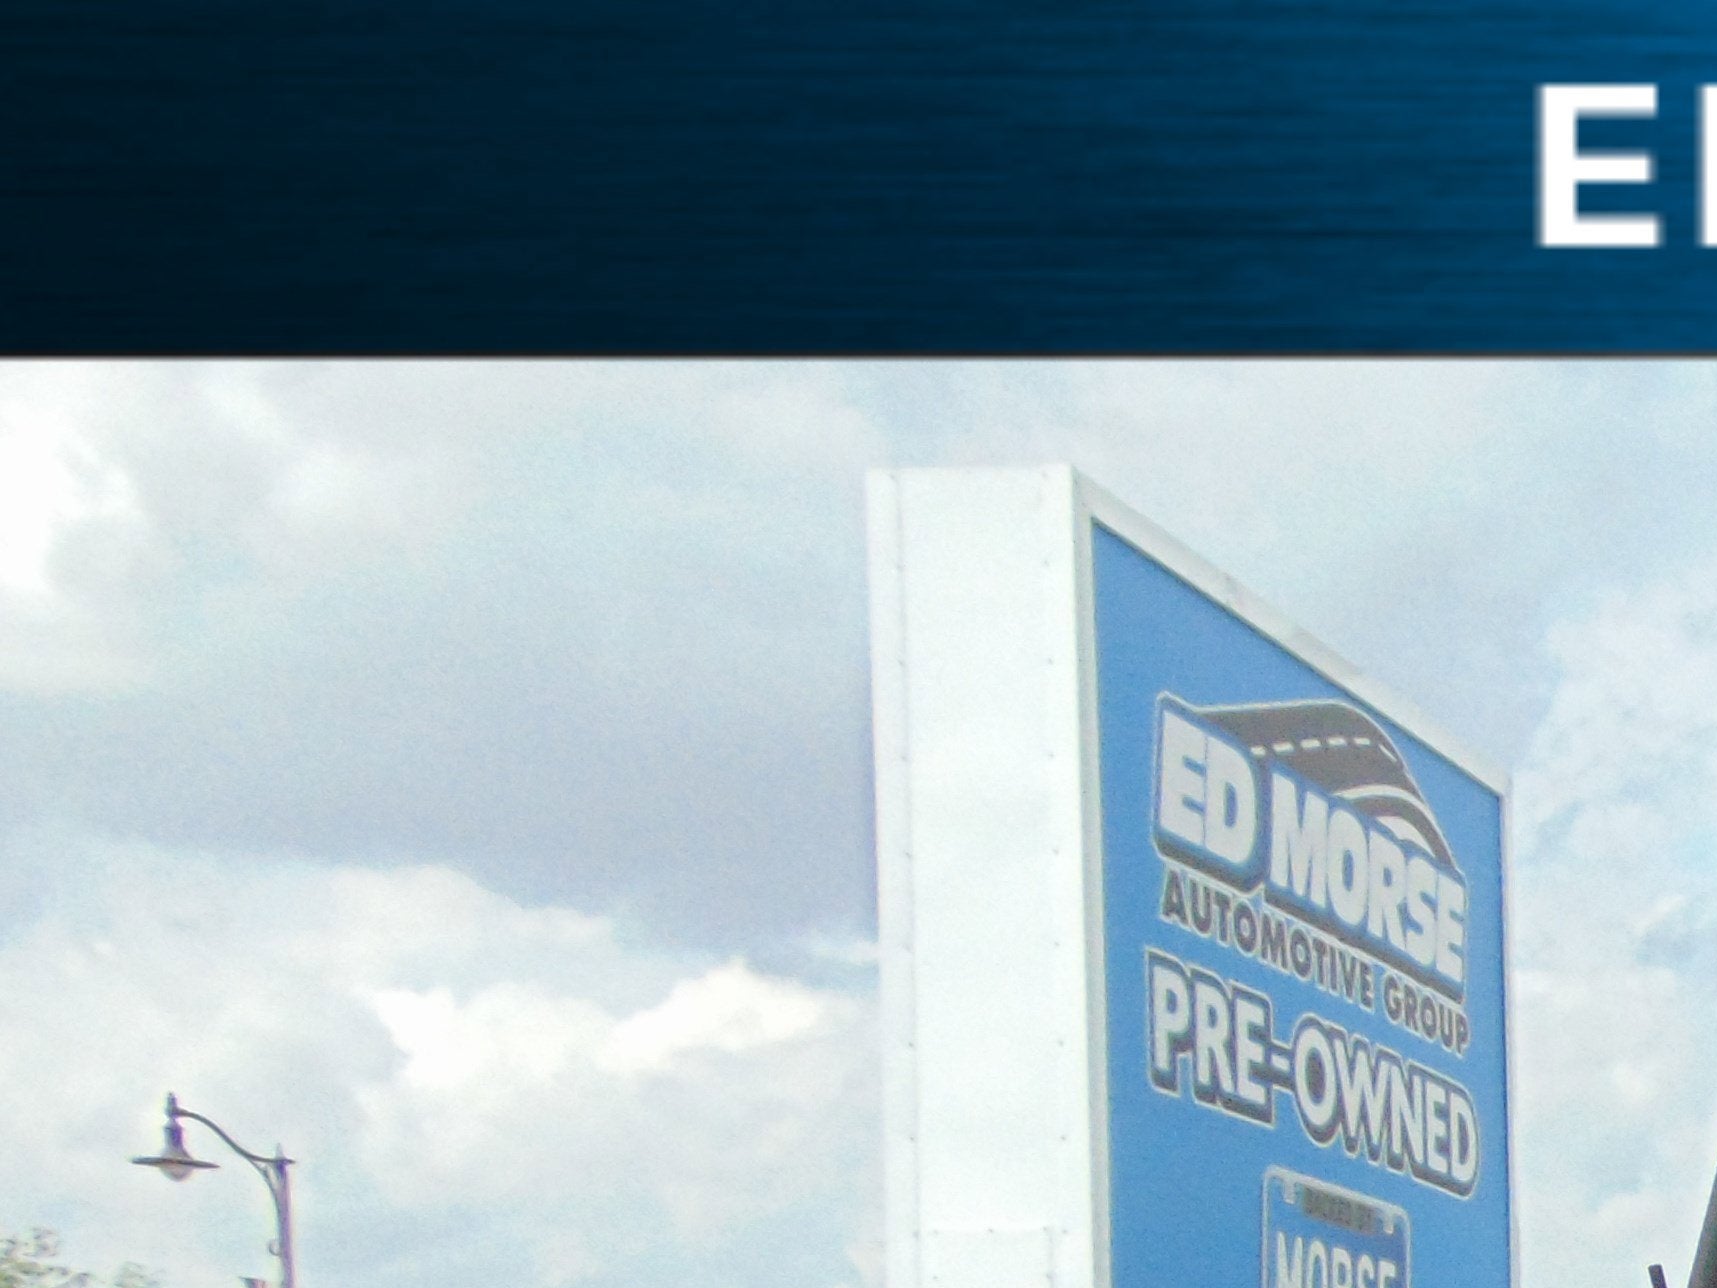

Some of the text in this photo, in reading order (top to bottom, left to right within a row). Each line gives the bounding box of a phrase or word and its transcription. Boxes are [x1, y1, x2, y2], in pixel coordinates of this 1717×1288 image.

[1159, 709, 1465, 983] ED MORSE
[1160, 867, 1468, 1055] AUTOMOTIVE GROUP
[1151, 963, 1479, 1184] PRE-OWNED
